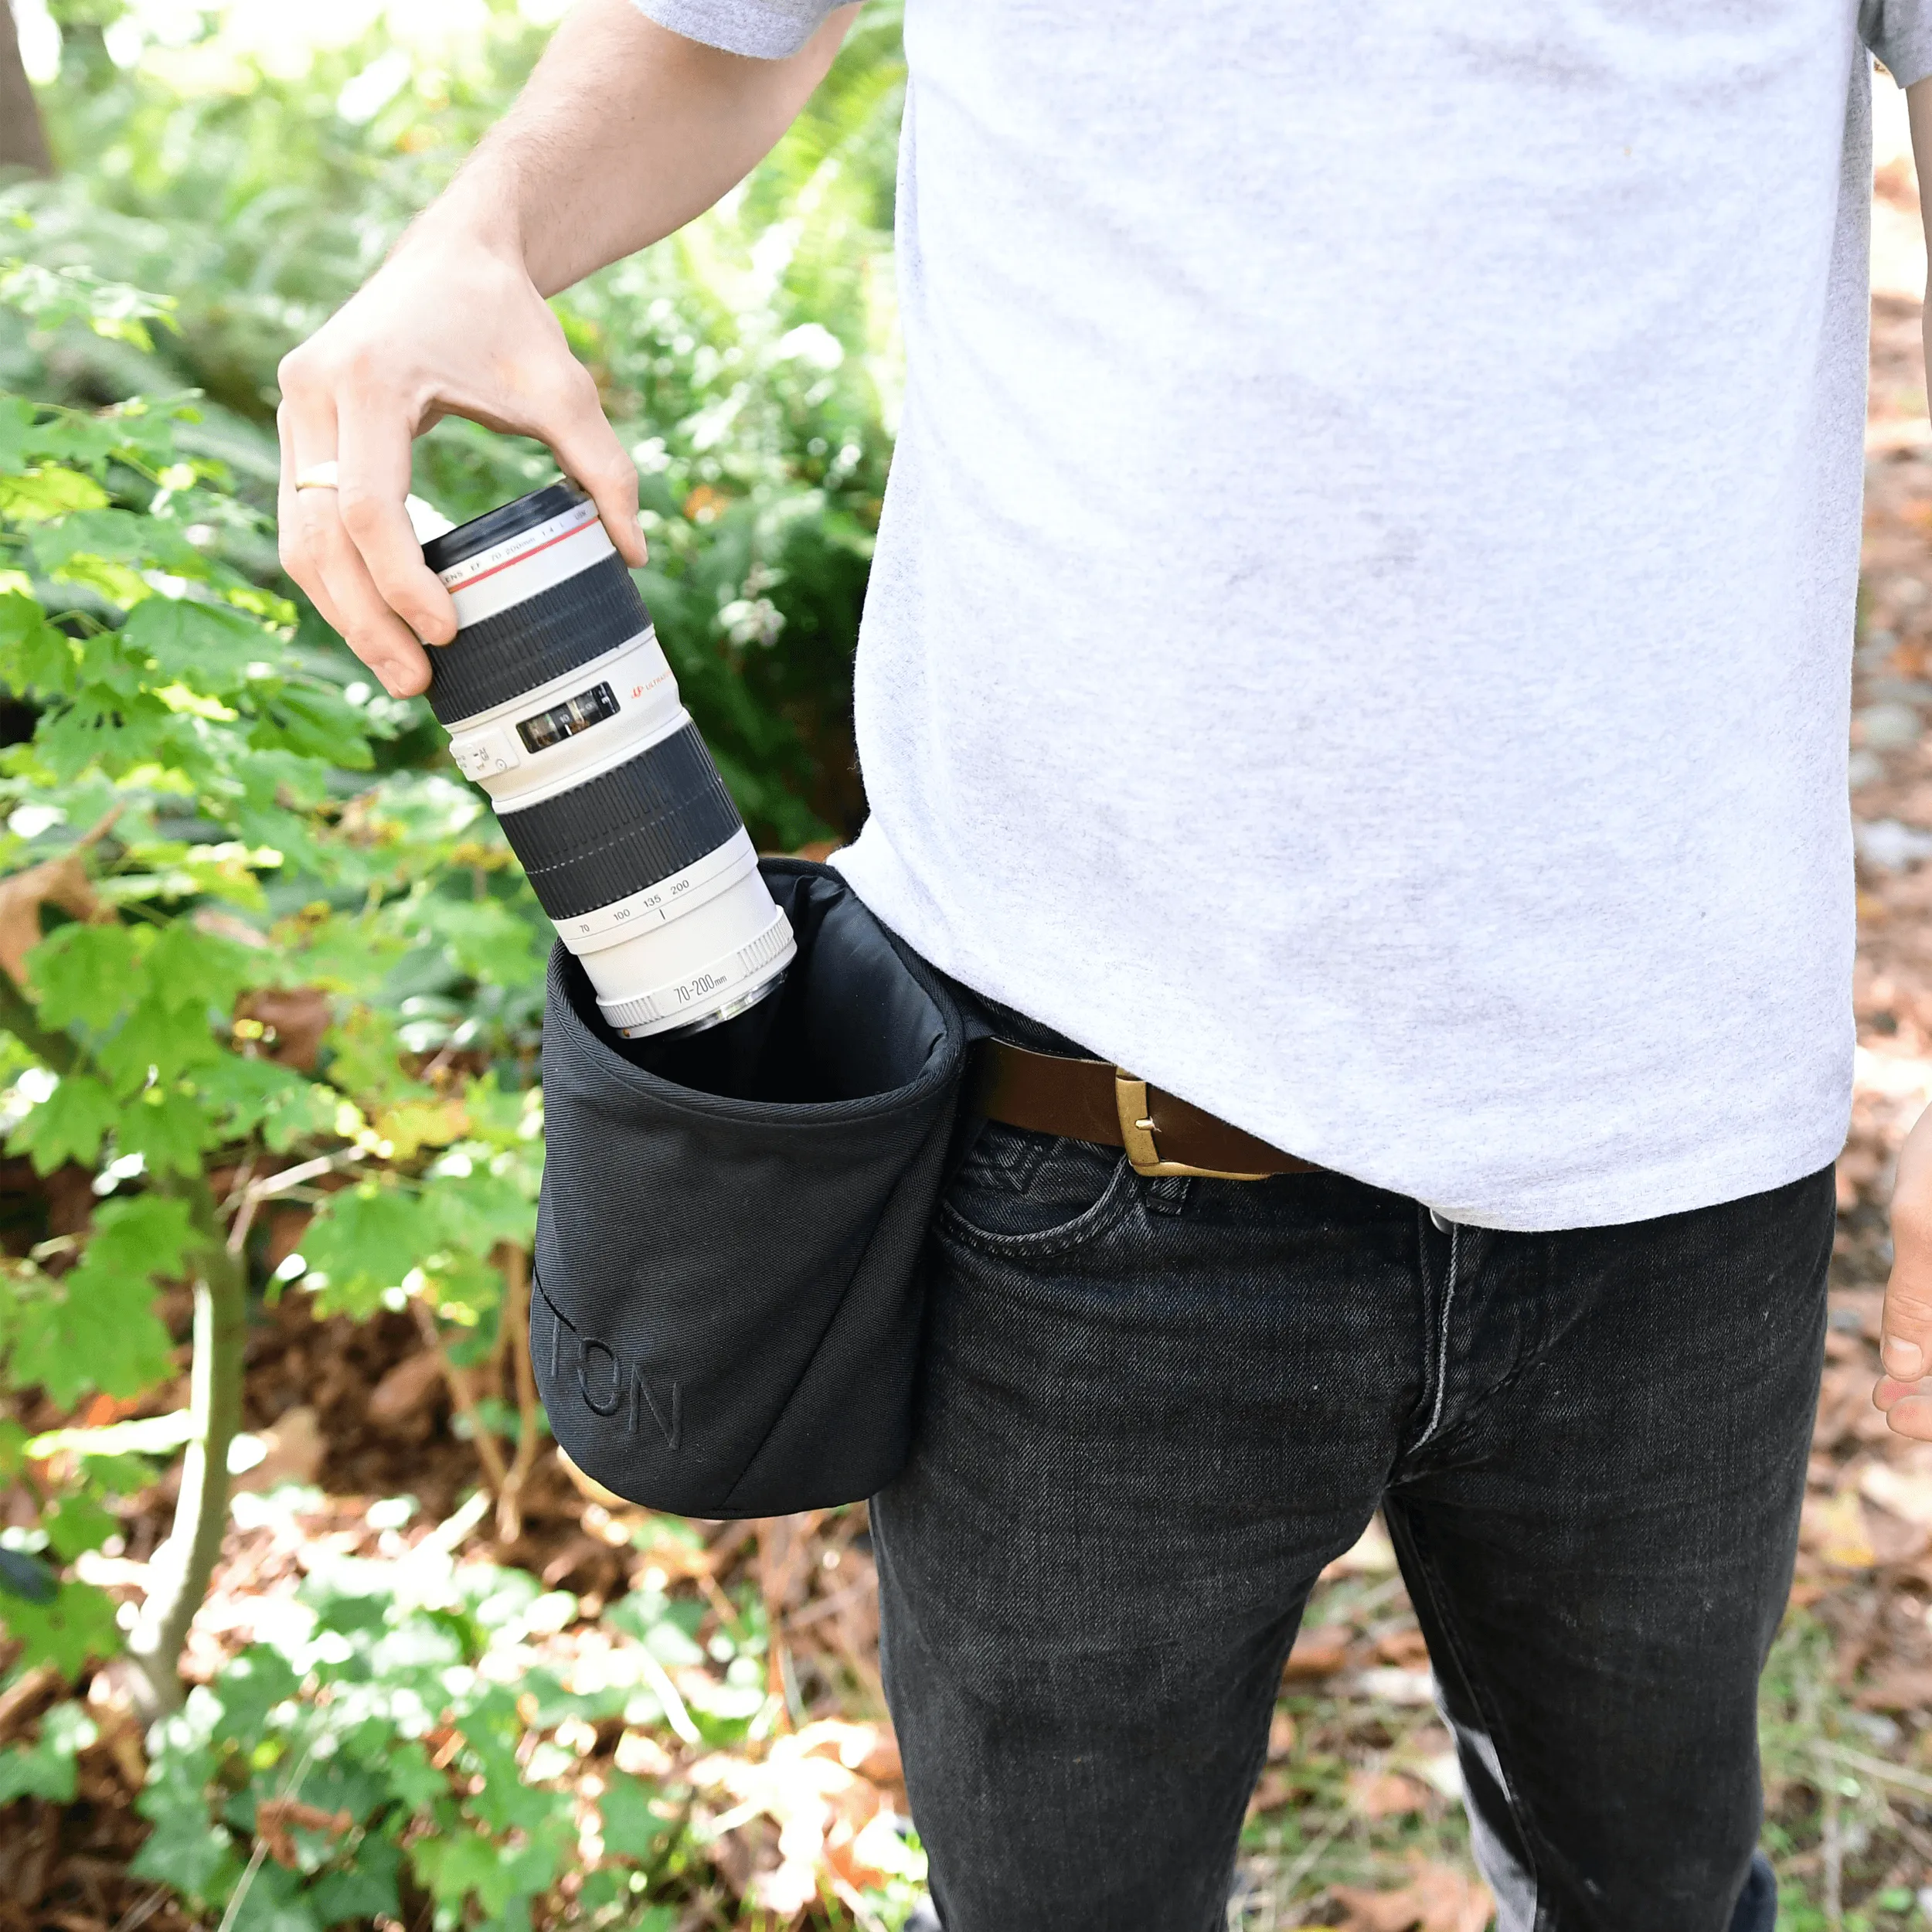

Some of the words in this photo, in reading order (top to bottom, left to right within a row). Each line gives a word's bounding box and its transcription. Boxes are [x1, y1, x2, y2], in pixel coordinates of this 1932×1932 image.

[670, 879, 690, 895] 200
[642, 894, 662, 908] 135
[613, 908, 631, 921] 100
[579, 923, 590, 934] 70
[673, 974, 727, 1004] 70-200mm
